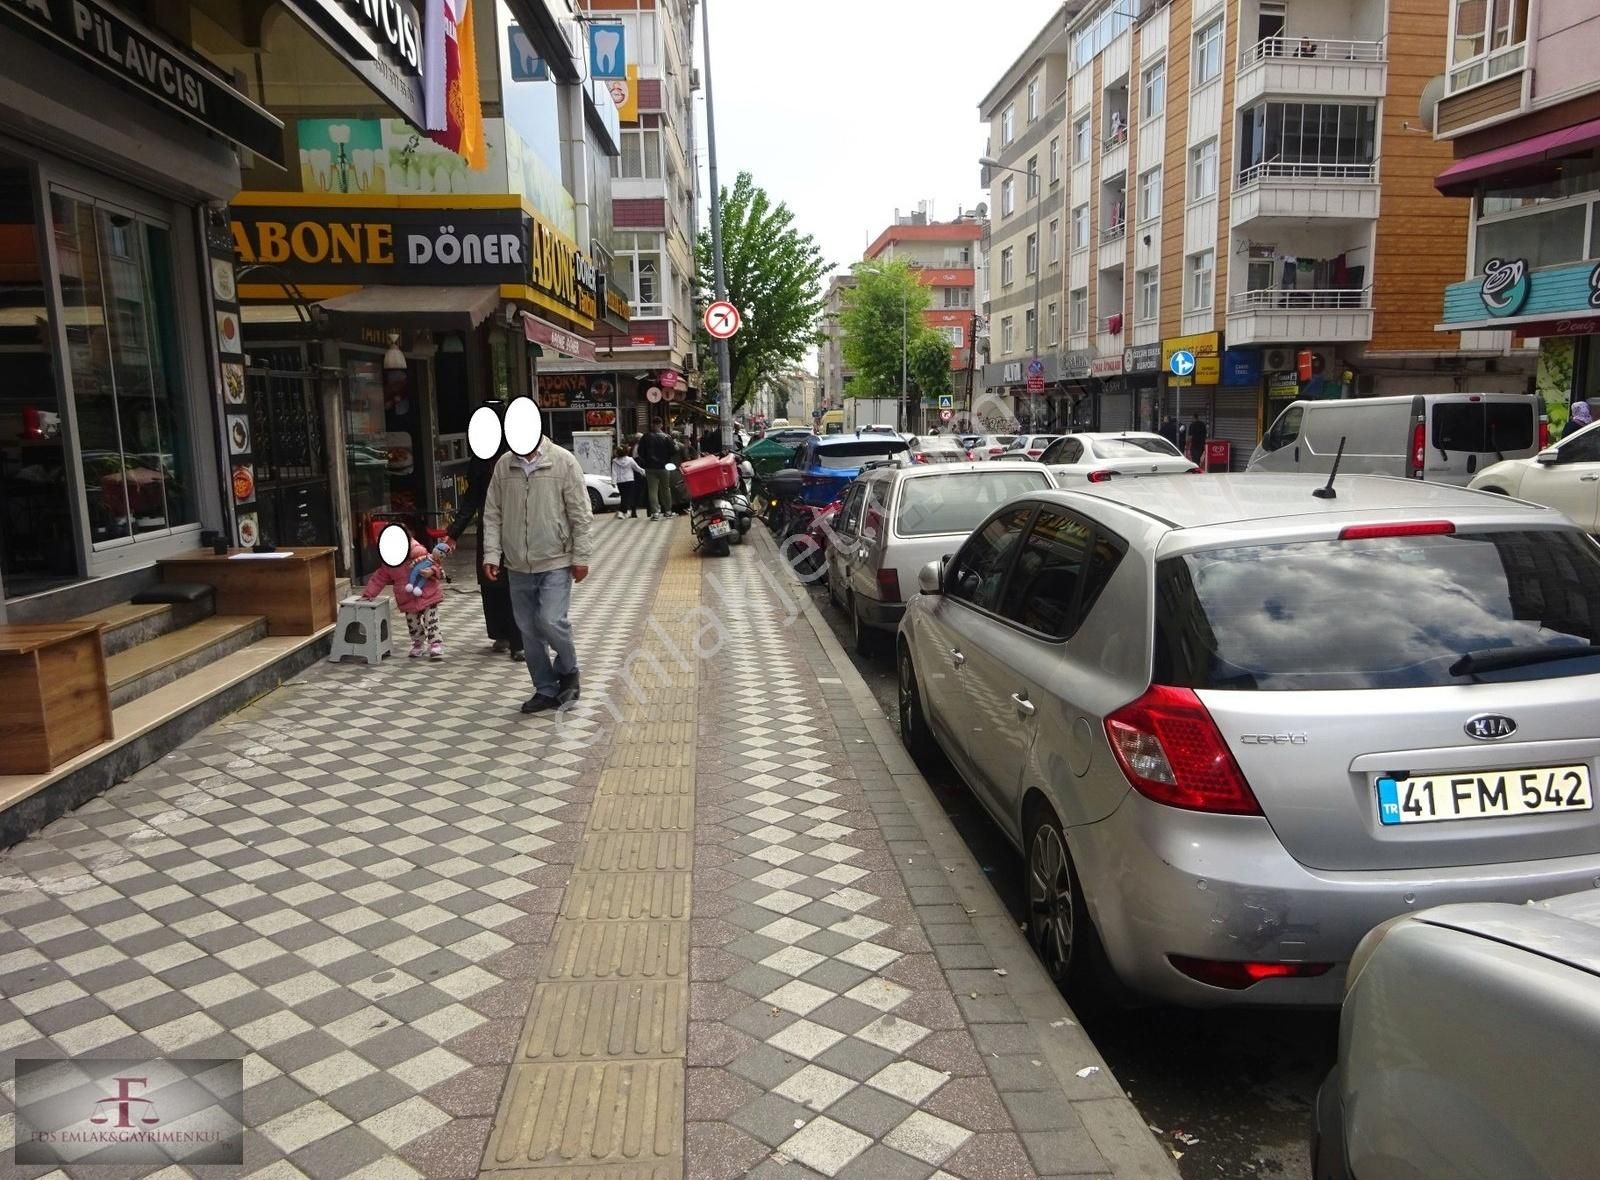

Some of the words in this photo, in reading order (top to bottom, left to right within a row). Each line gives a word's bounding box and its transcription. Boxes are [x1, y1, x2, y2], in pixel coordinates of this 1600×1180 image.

[229, 220, 394, 265] ABONE
[407, 224, 523, 265] DÖNER
[1474, 718, 1511, 736] KIA
[1383, 802, 1398, 814] TR
[1402, 780, 1436, 817] 41
[1450, 776, 1509, 814] FM
[1520, 771, 1586, 810] 542
